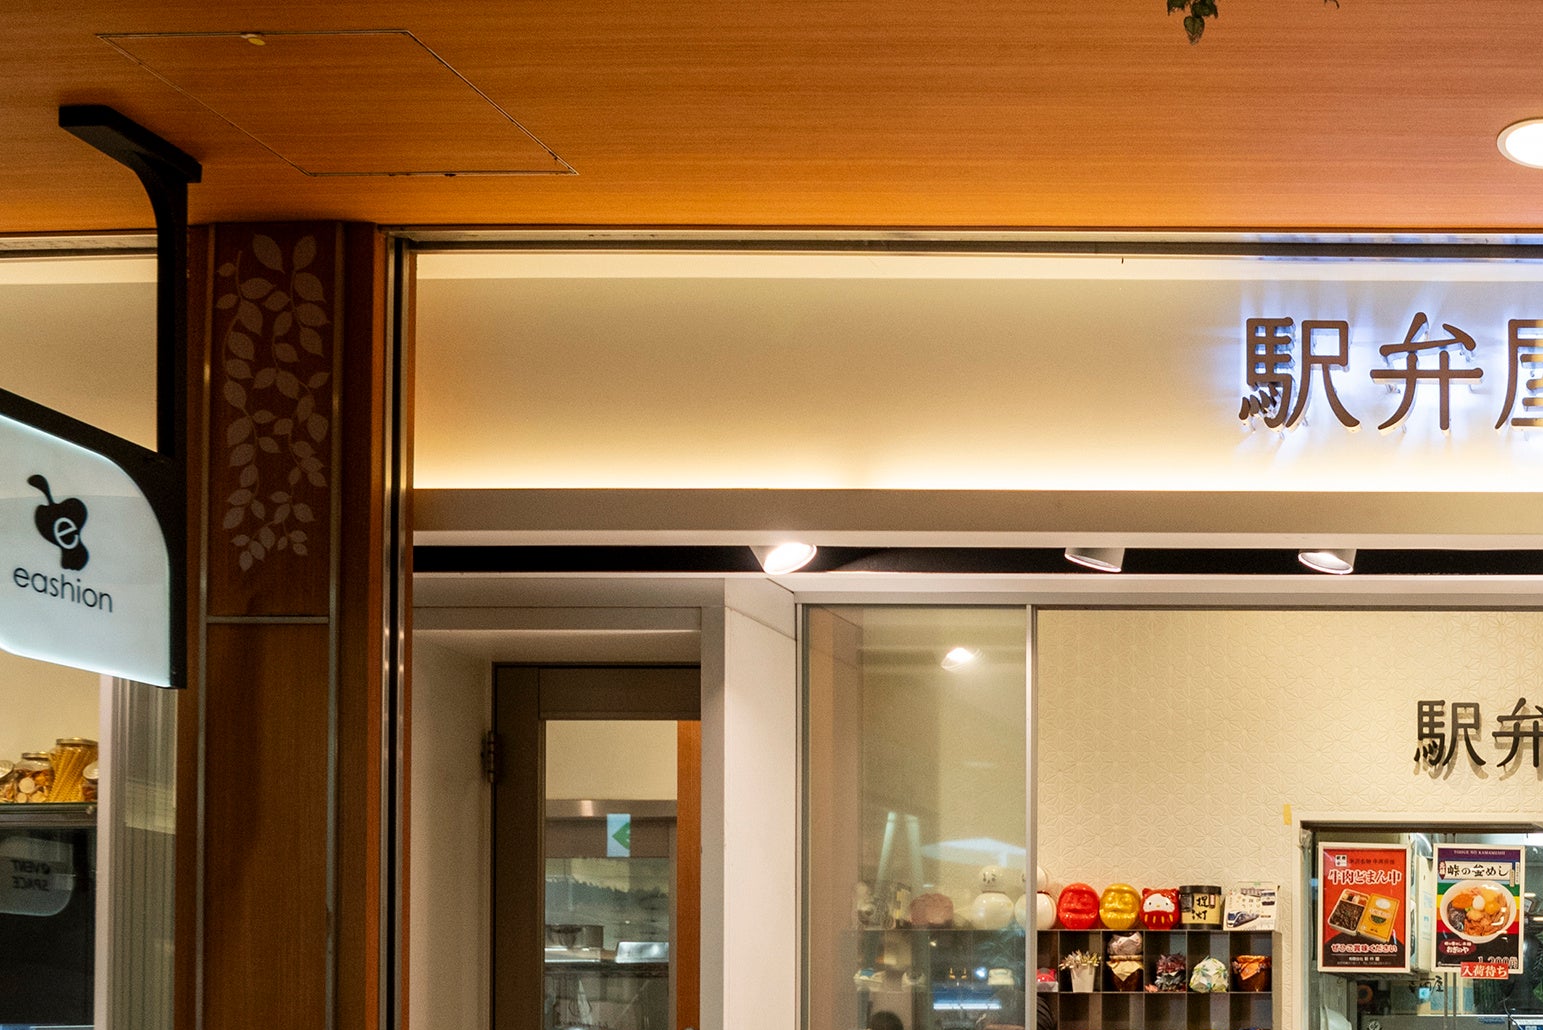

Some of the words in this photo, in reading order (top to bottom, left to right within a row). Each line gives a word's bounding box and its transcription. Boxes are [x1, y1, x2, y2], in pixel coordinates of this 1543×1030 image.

[12, 566, 114, 613] eashion
[1328, 868, 1402, 886] 牛肉どまん中
[1447, 863, 1510, 878] 峠の釜めし
[1461, 965, 1507, 977] 入荷待ち
